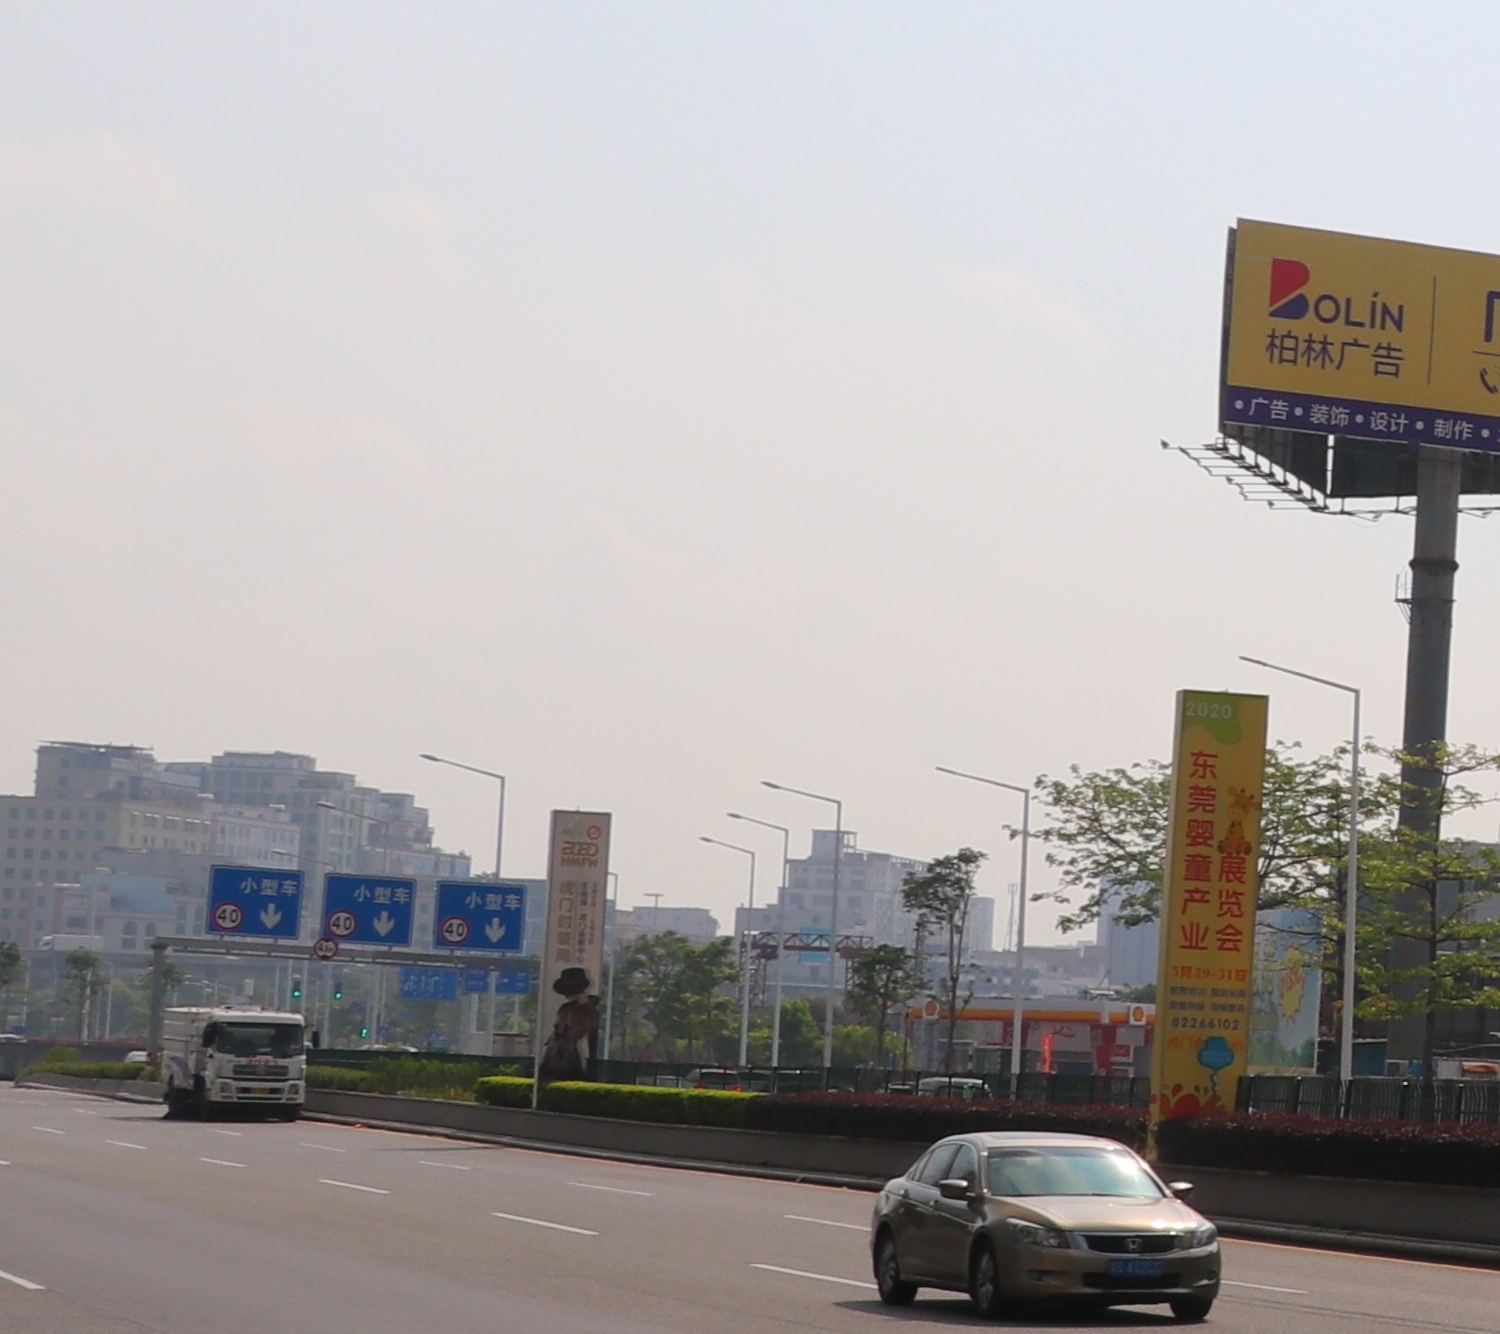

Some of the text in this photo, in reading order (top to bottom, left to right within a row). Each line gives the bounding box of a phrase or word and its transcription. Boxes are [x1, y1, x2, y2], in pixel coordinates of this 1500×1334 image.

[1265, 328, 1404, 379] 柏林广告
[1250, 397, 1290, 421] 广告
[1309, 403, 1349, 427] 装饰
[1370, 410, 1410, 434] 设计
[1434, 417, 1473, 441] 制作
[1185, 700, 1232, 719] 2020
[1179, 750, 1219, 952] 东莞婴童产业
[240, 876, 298, 897] 小型车
[353, 883, 411, 905] 小型车
[465, 892, 521, 912] 小型车
[1214, 853, 1247, 954] 展览会
[217, 909, 239, 924] 40
[331, 916, 352, 931] 40
[445, 922, 466, 937] 40
[1171, 1016, 1240, 1031] 82266102
